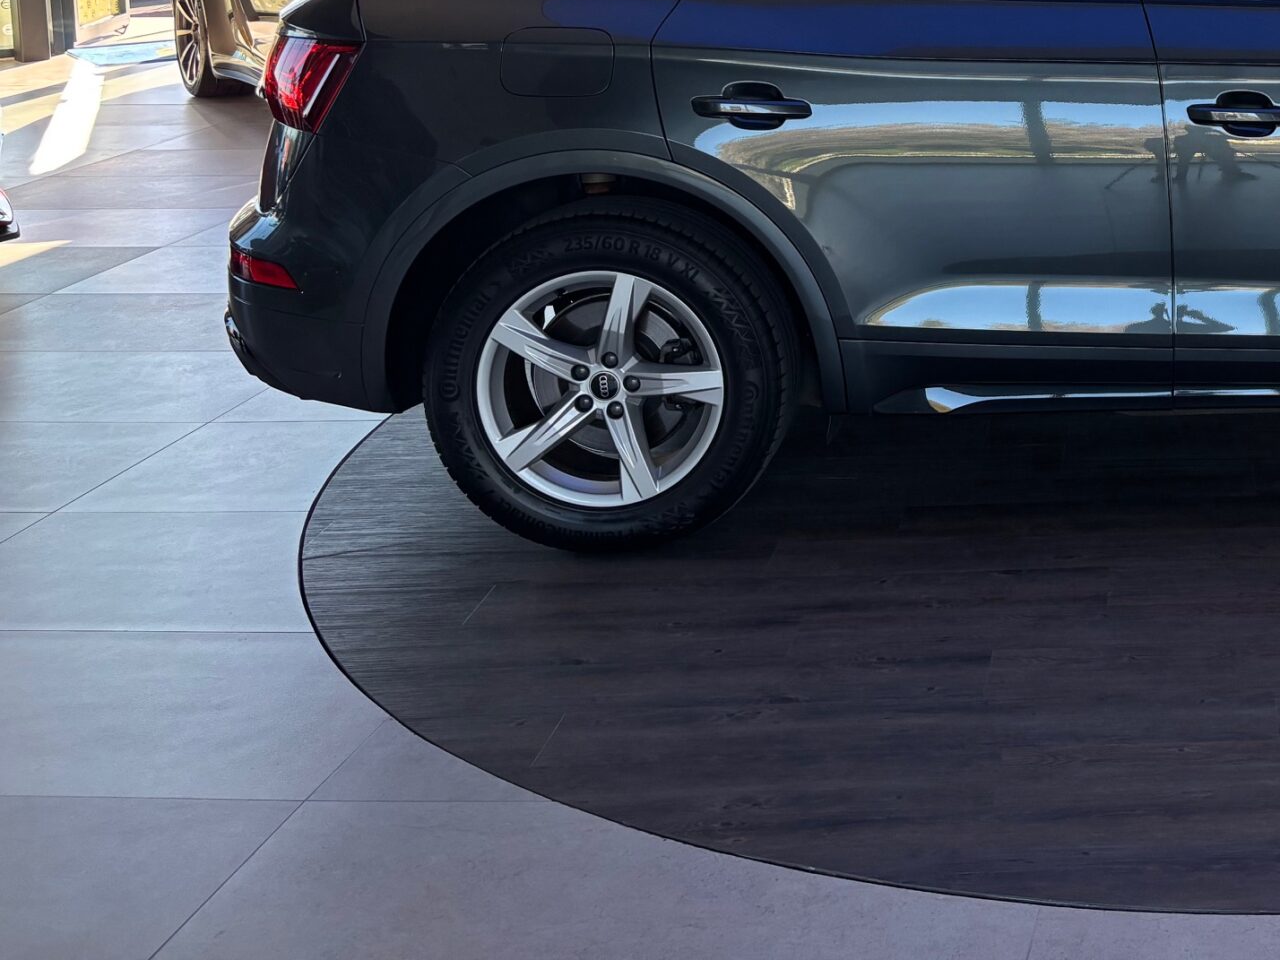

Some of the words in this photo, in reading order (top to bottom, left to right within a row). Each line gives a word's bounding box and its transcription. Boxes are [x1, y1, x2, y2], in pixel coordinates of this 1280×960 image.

[563, 234, 626, 252] 235/60
[628, 239, 641, 255] R
[644, 243, 661, 261] 18
[681, 261, 700, 281] XL
